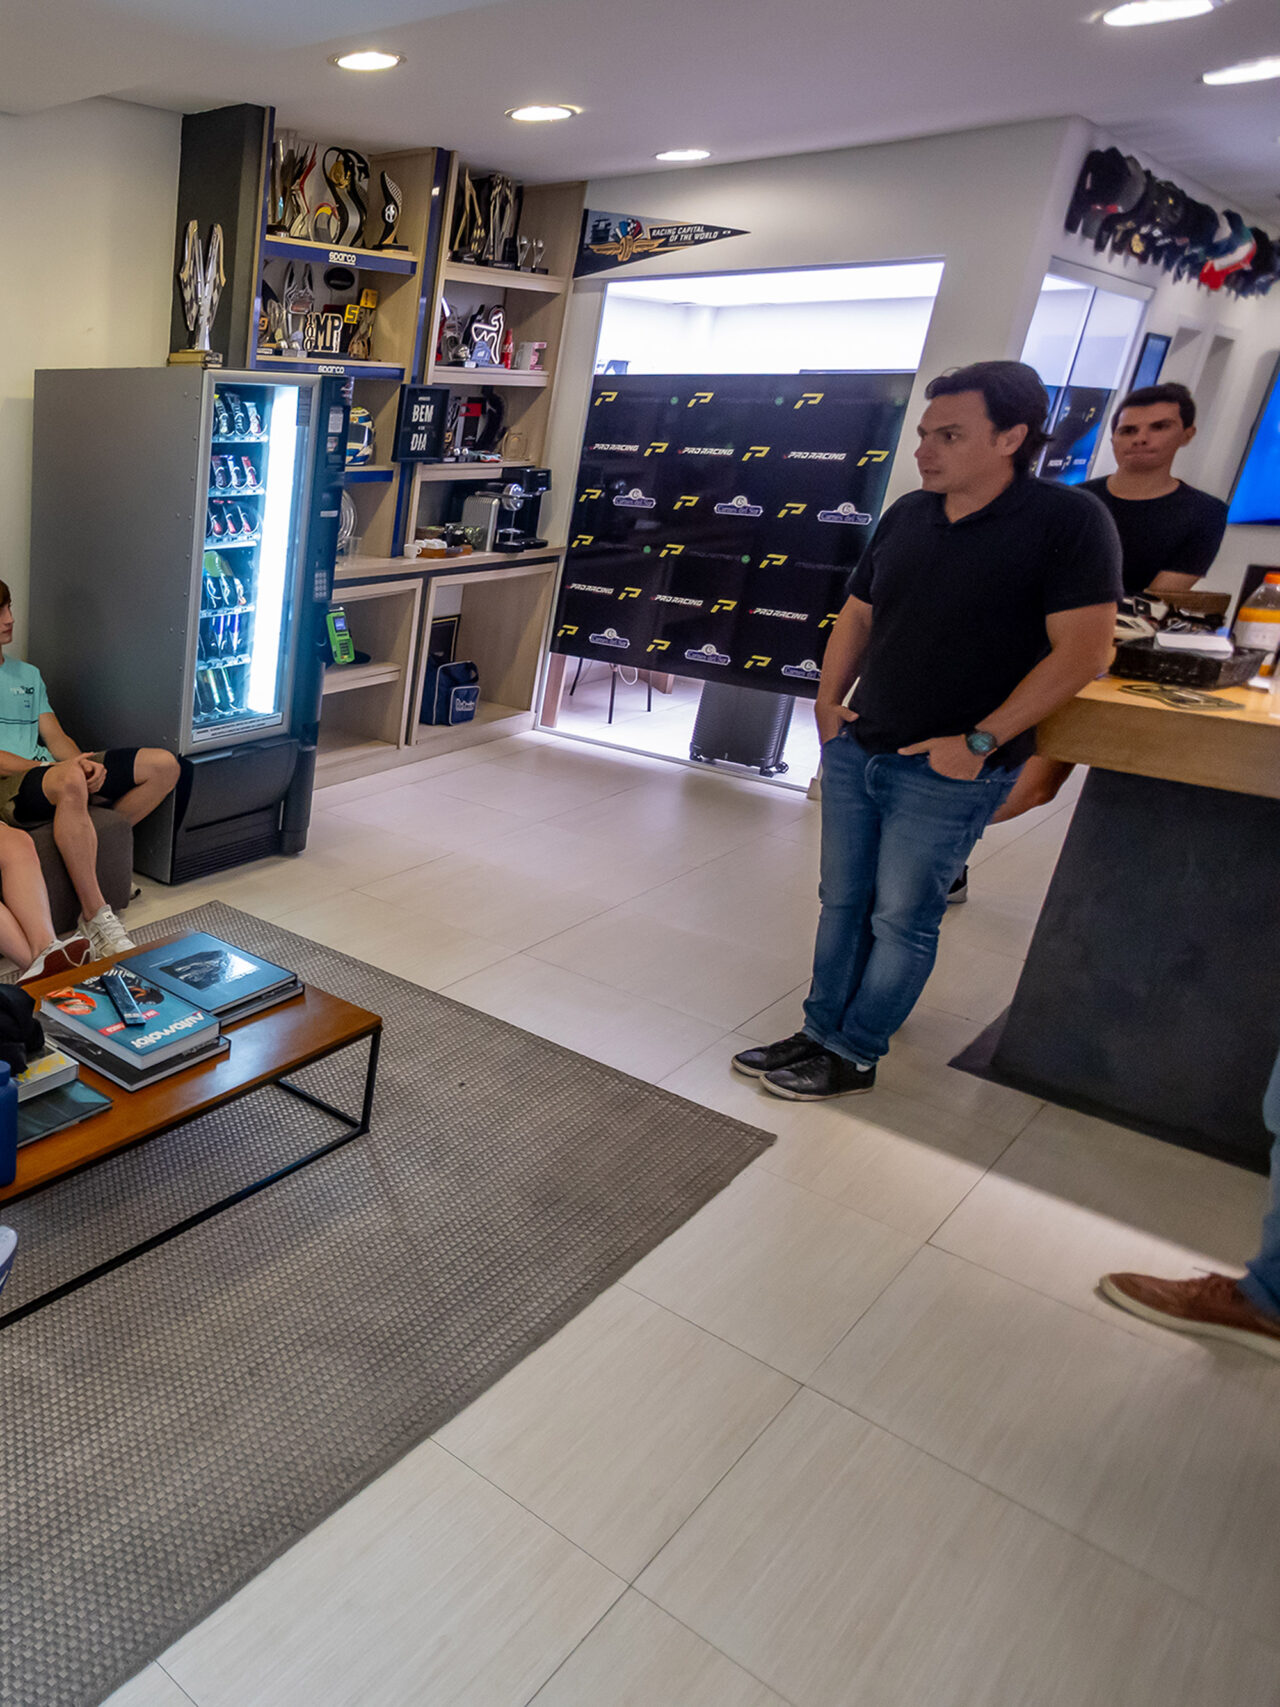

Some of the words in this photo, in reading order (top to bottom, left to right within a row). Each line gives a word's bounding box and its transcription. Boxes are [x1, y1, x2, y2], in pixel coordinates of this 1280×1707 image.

[652, 228, 677, 237] RACING
[677, 226, 705, 235] CAPITAL
[670, 234, 678, 242] OF
[679, 233, 692, 241] THE
[694, 231, 719, 240] WORLD
[329, 251, 357, 265] sparco
[412, 404, 434, 423] BEM
[410, 433, 428, 451] DIA
[788, 451, 810, 459] PRO
[810, 452, 847, 460] RACING
[753, 607, 773, 616] PRO
[773, 609, 808, 621] RACING
